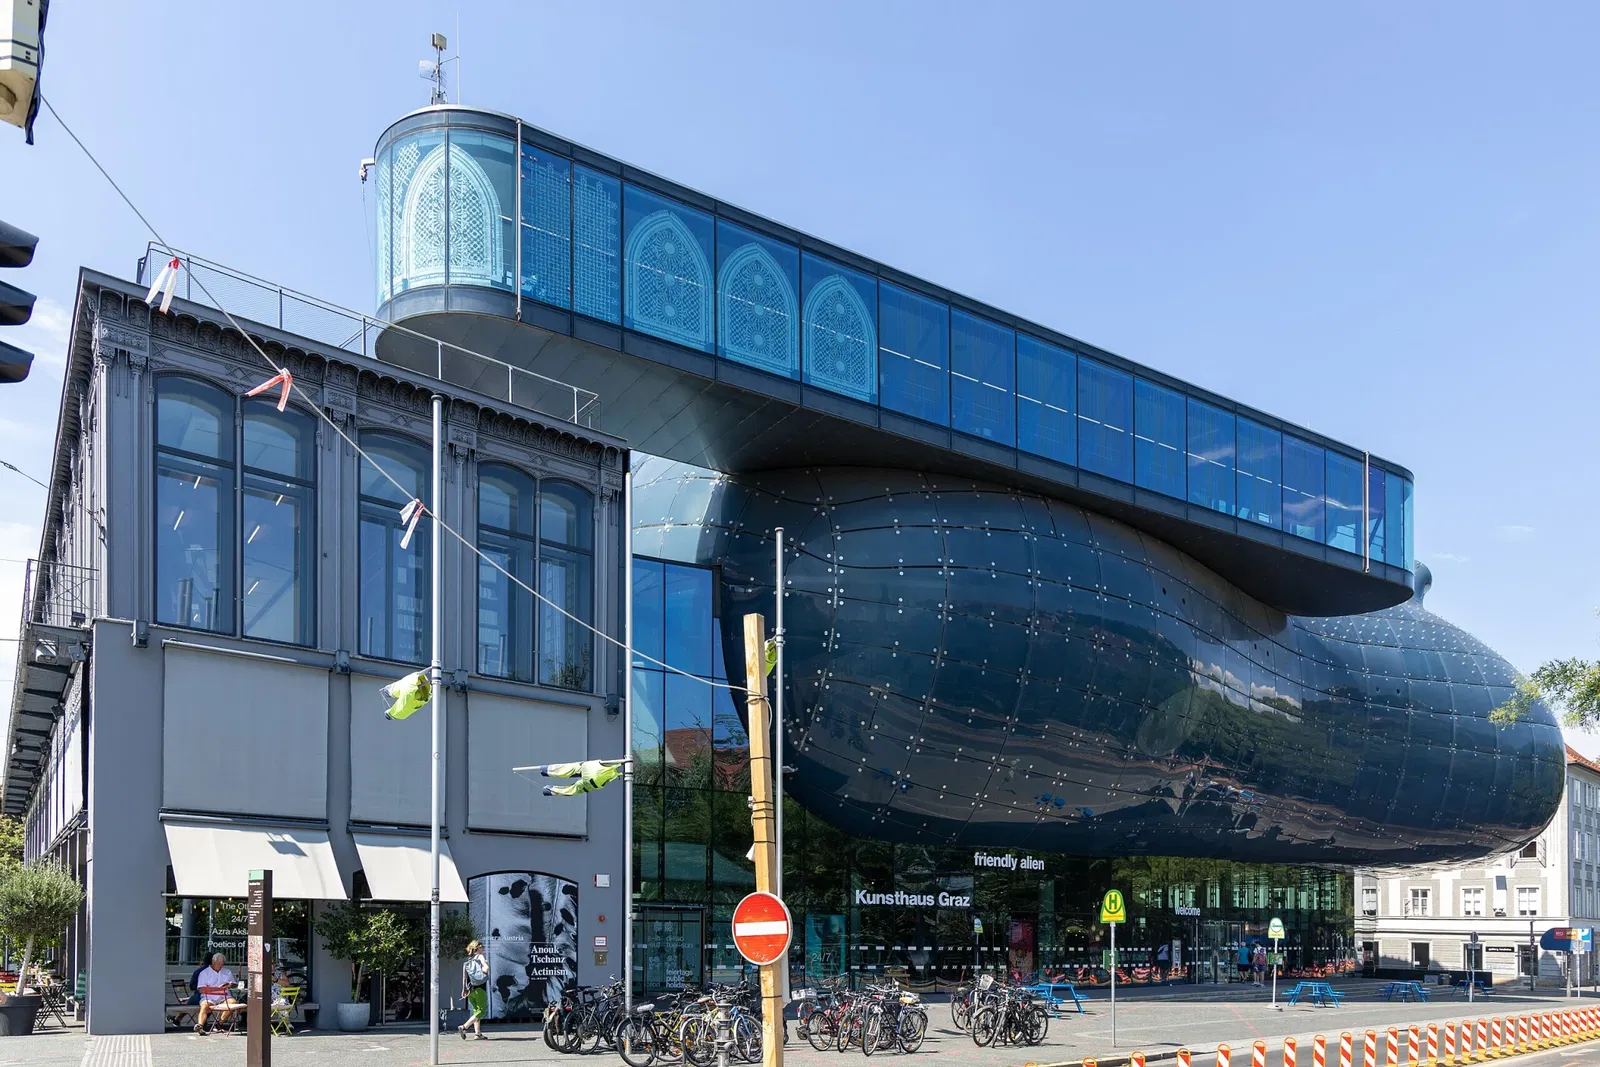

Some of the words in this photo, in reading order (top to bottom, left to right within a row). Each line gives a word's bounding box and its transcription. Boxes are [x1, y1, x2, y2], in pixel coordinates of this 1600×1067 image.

[974, 852, 1017, 870] friendly
[1020, 854, 1045, 870] alien
[855, 889, 935, 906] Kunsthaus
[938, 892, 970, 907] Graz
[1109, 894, 1118, 910] H
[1175, 905, 1201, 916] welcome
[231, 915, 248, 923] 24/7
[207, 940, 236, 948] Poetics
[238, 940, 246, 948] of
[531, 945, 559, 954] Anouk
[531, 955, 566, 963] Tschanz
[811, 952, 831, 962] 24/7
[531, 967, 568, 976] Actinism
